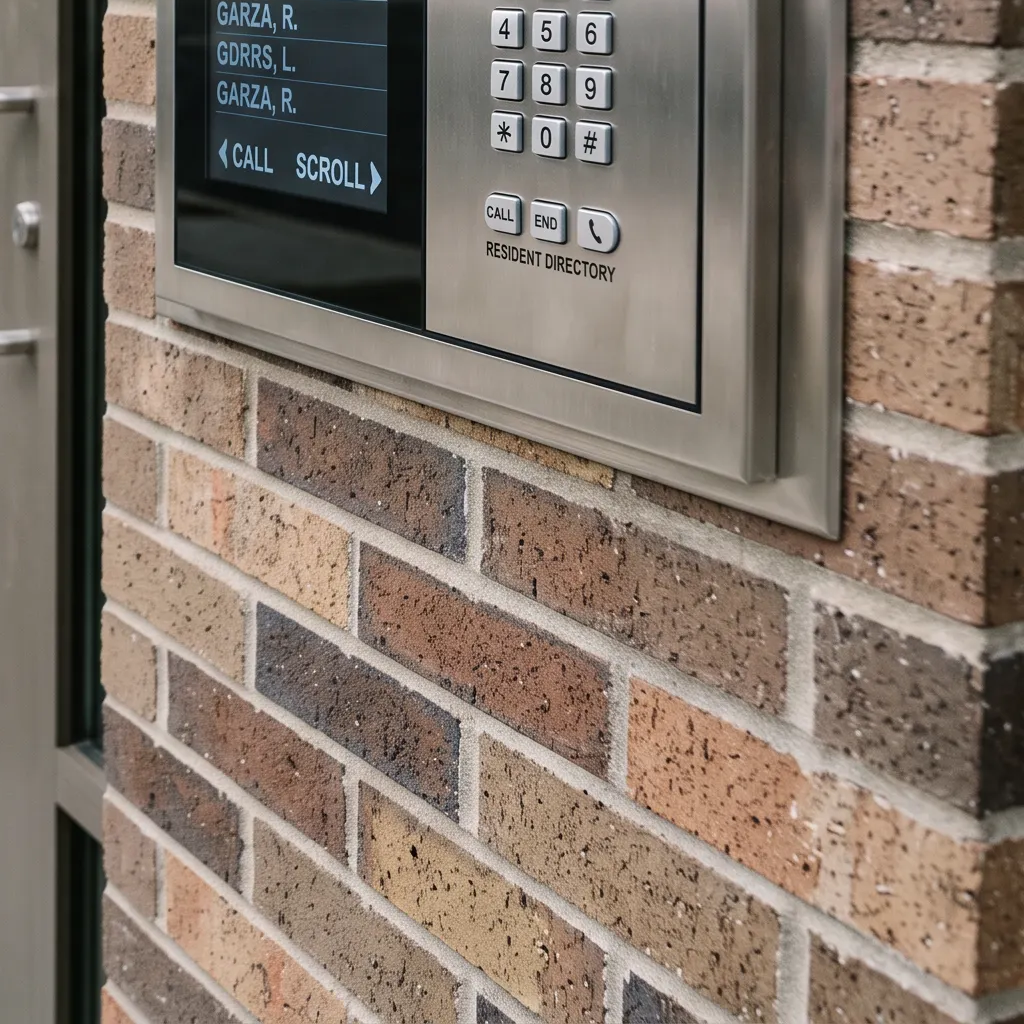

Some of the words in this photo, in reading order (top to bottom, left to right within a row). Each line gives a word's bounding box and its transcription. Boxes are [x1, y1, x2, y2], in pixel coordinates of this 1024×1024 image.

[217, 1, 276, 34] GARZA,
[282, 4, 298, 30] R.
[498, 18, 510, 40] 4
[540, 20, 552, 42] 5
[585, 22, 597, 45] 6
[217, 41, 276, 75] GDRRS,
[282, 46, 296, 72] L.
[217, 80, 276, 116] GARZA,
[281, 87, 297, 114] R.
[499, 70, 510, 91] 7
[540, 73, 552, 96] 8
[584, 77, 596, 100] 9
[540, 126, 552, 149] 0
[583, 131, 598, 155] #
[232, 142, 274, 174] CALL
[296, 152, 365, 190] SCROLL
[486, 205, 514, 223] CALL
[534, 214, 558, 231] END
[486, 241, 542, 267] RESIDENT
[545, 253, 616, 283] DIRECTORY
